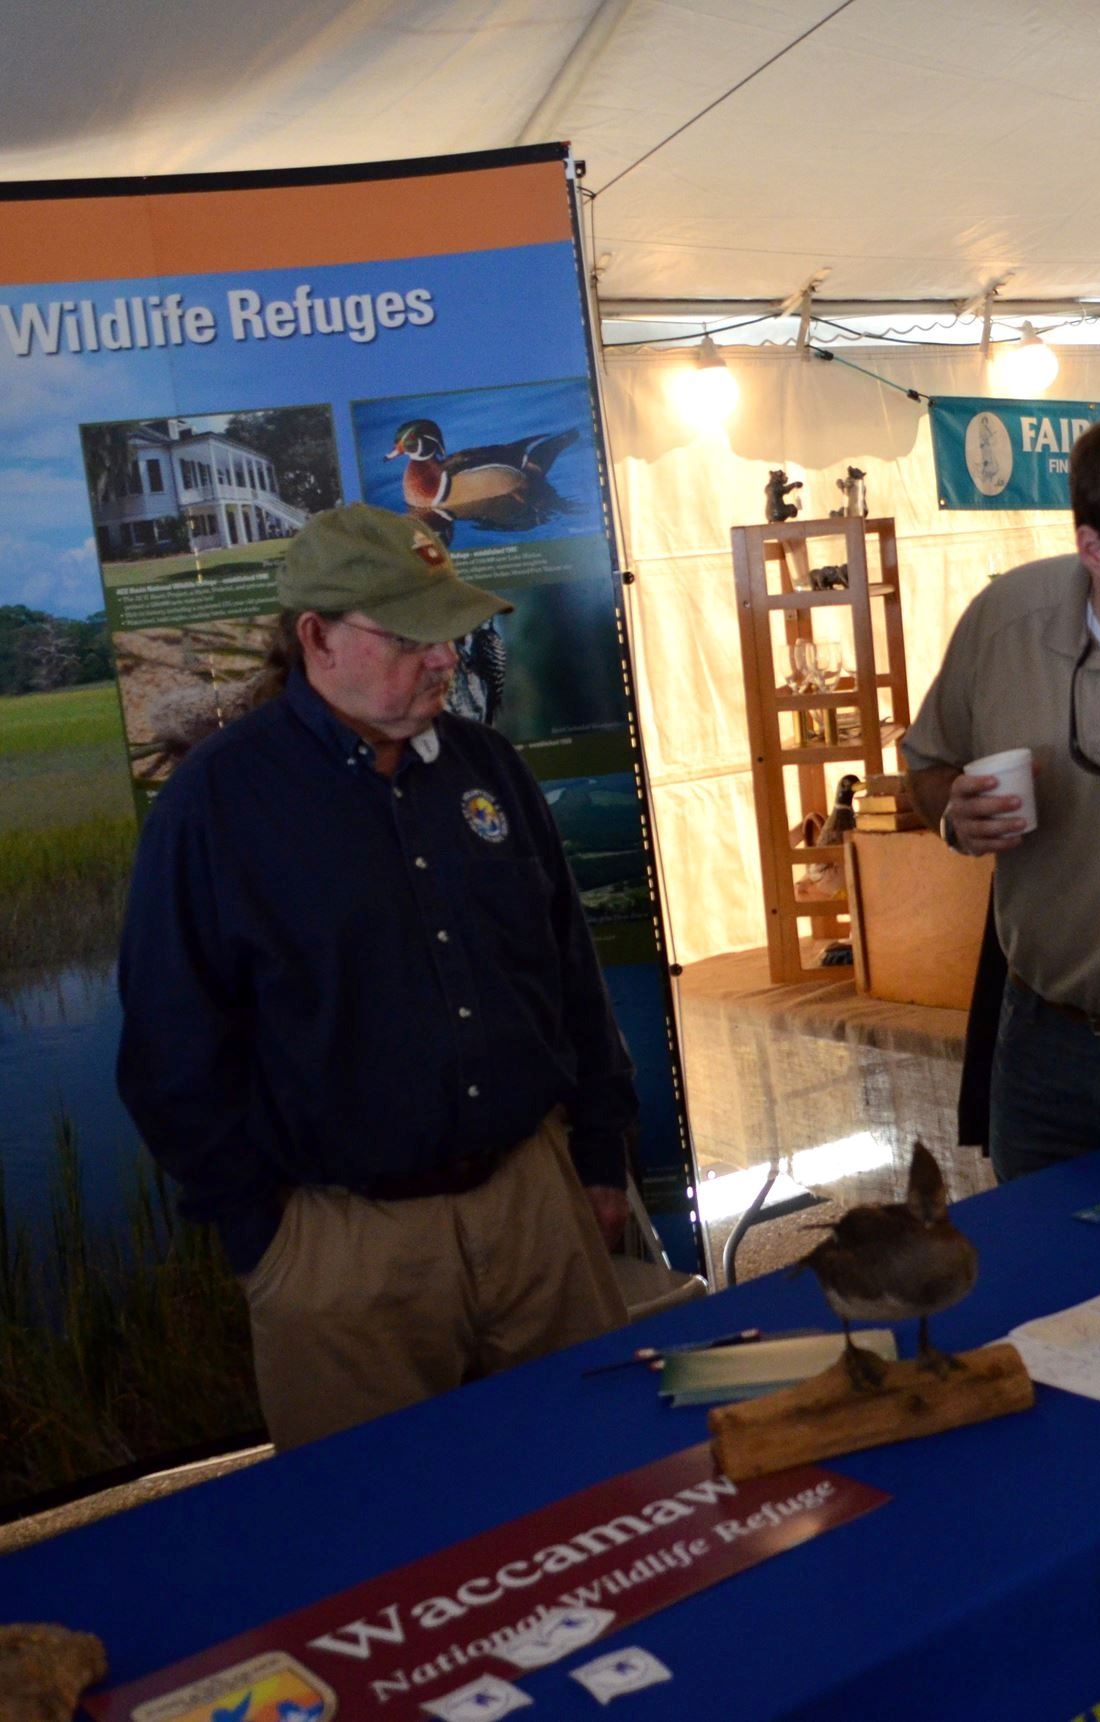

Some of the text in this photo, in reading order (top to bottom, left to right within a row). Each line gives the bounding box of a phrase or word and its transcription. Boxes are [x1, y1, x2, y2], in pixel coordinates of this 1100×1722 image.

[2, 285, 435, 356] Wildlife Refuges
[305, 1475, 738, 1660] Waccamaw
[369, 1604, 552, 1704] National
[559, 1535, 711, 1608] Wildlife
[713, 1479, 836, 1543] Refuge
